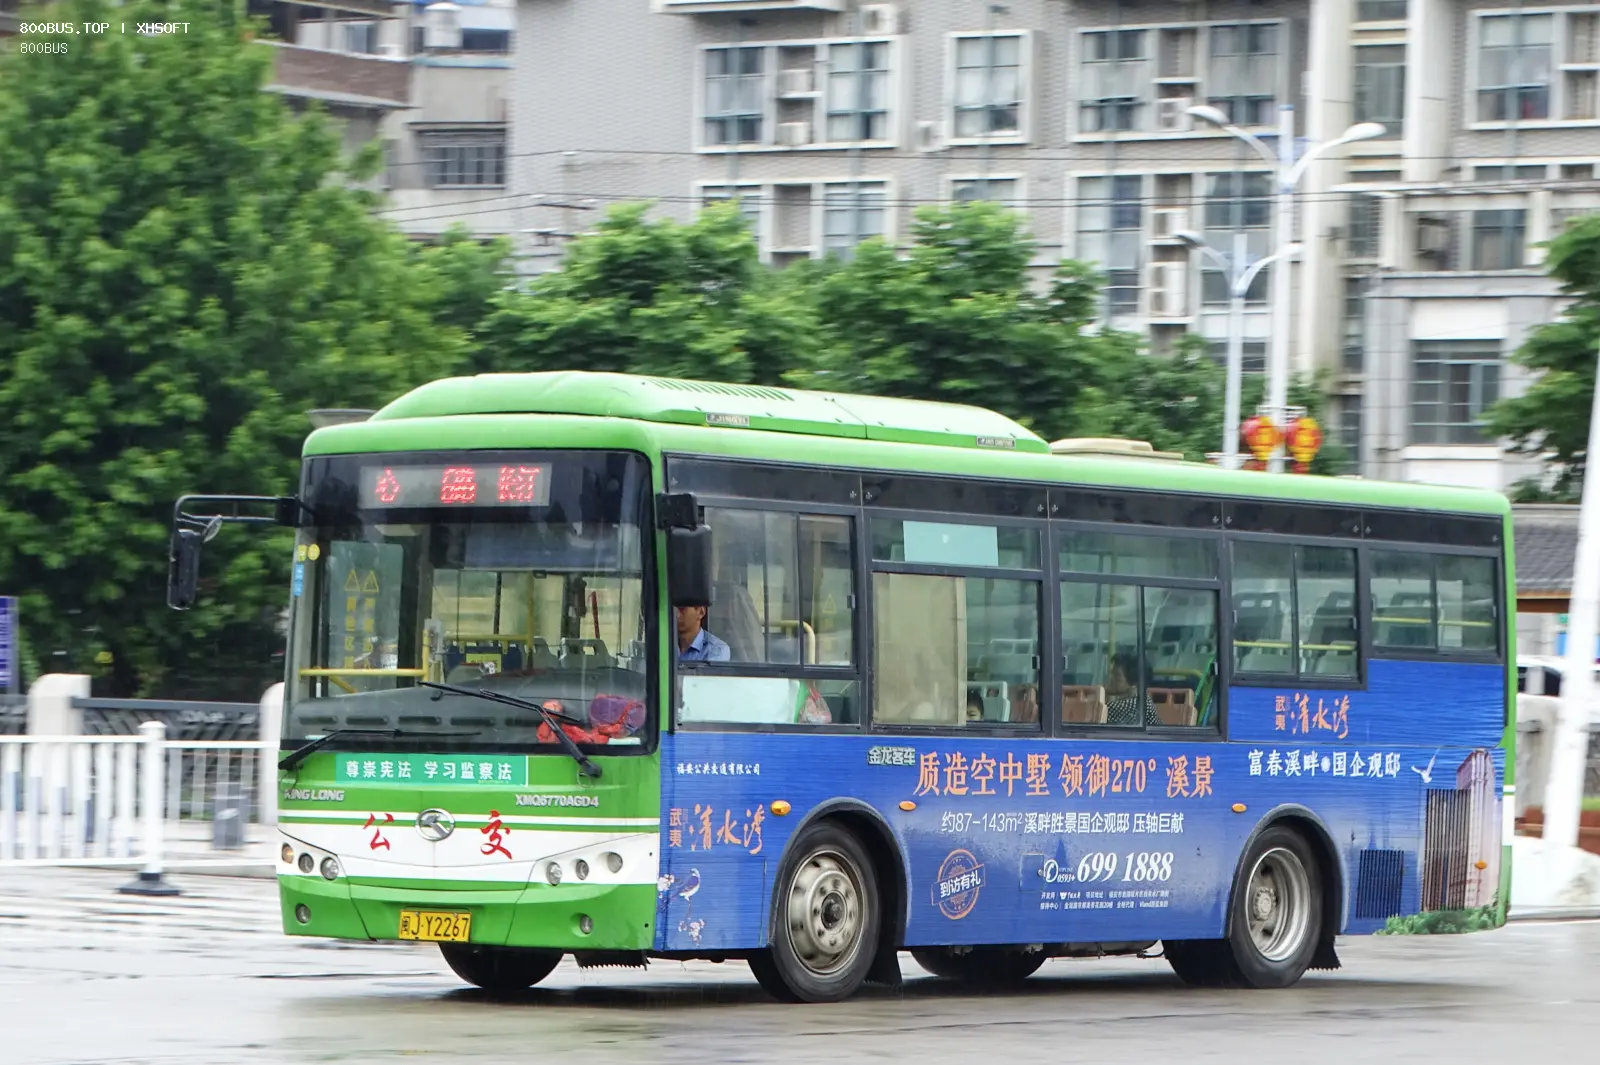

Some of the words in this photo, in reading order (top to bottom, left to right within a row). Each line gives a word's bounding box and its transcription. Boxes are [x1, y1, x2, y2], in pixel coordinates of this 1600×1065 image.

[868, 747, 916, 765] 金龙客车
[345, 761, 412, 778] 尊崇宪法
[424, 761, 512, 780] 学习监察法
[676, 762, 760, 776] 福安公共交通有限公司
[913, 751, 1050, 797] 质造空中墅
[1165, 754, 1215, 798] 溪景
[311, 789, 345, 801] LONG
[515, 794, 599, 807] XMQ6770AGD4
[669, 808, 682, 847] 武夷
[1132, 812, 1184, 834] 压轴巨献
[363, 812, 395, 850] 公
[480, 810, 512, 859] 交
[1077, 852, 1117, 883] 699
[1121, 852, 1174, 882] 1888
[940, 869, 981, 898] 到访有礼
